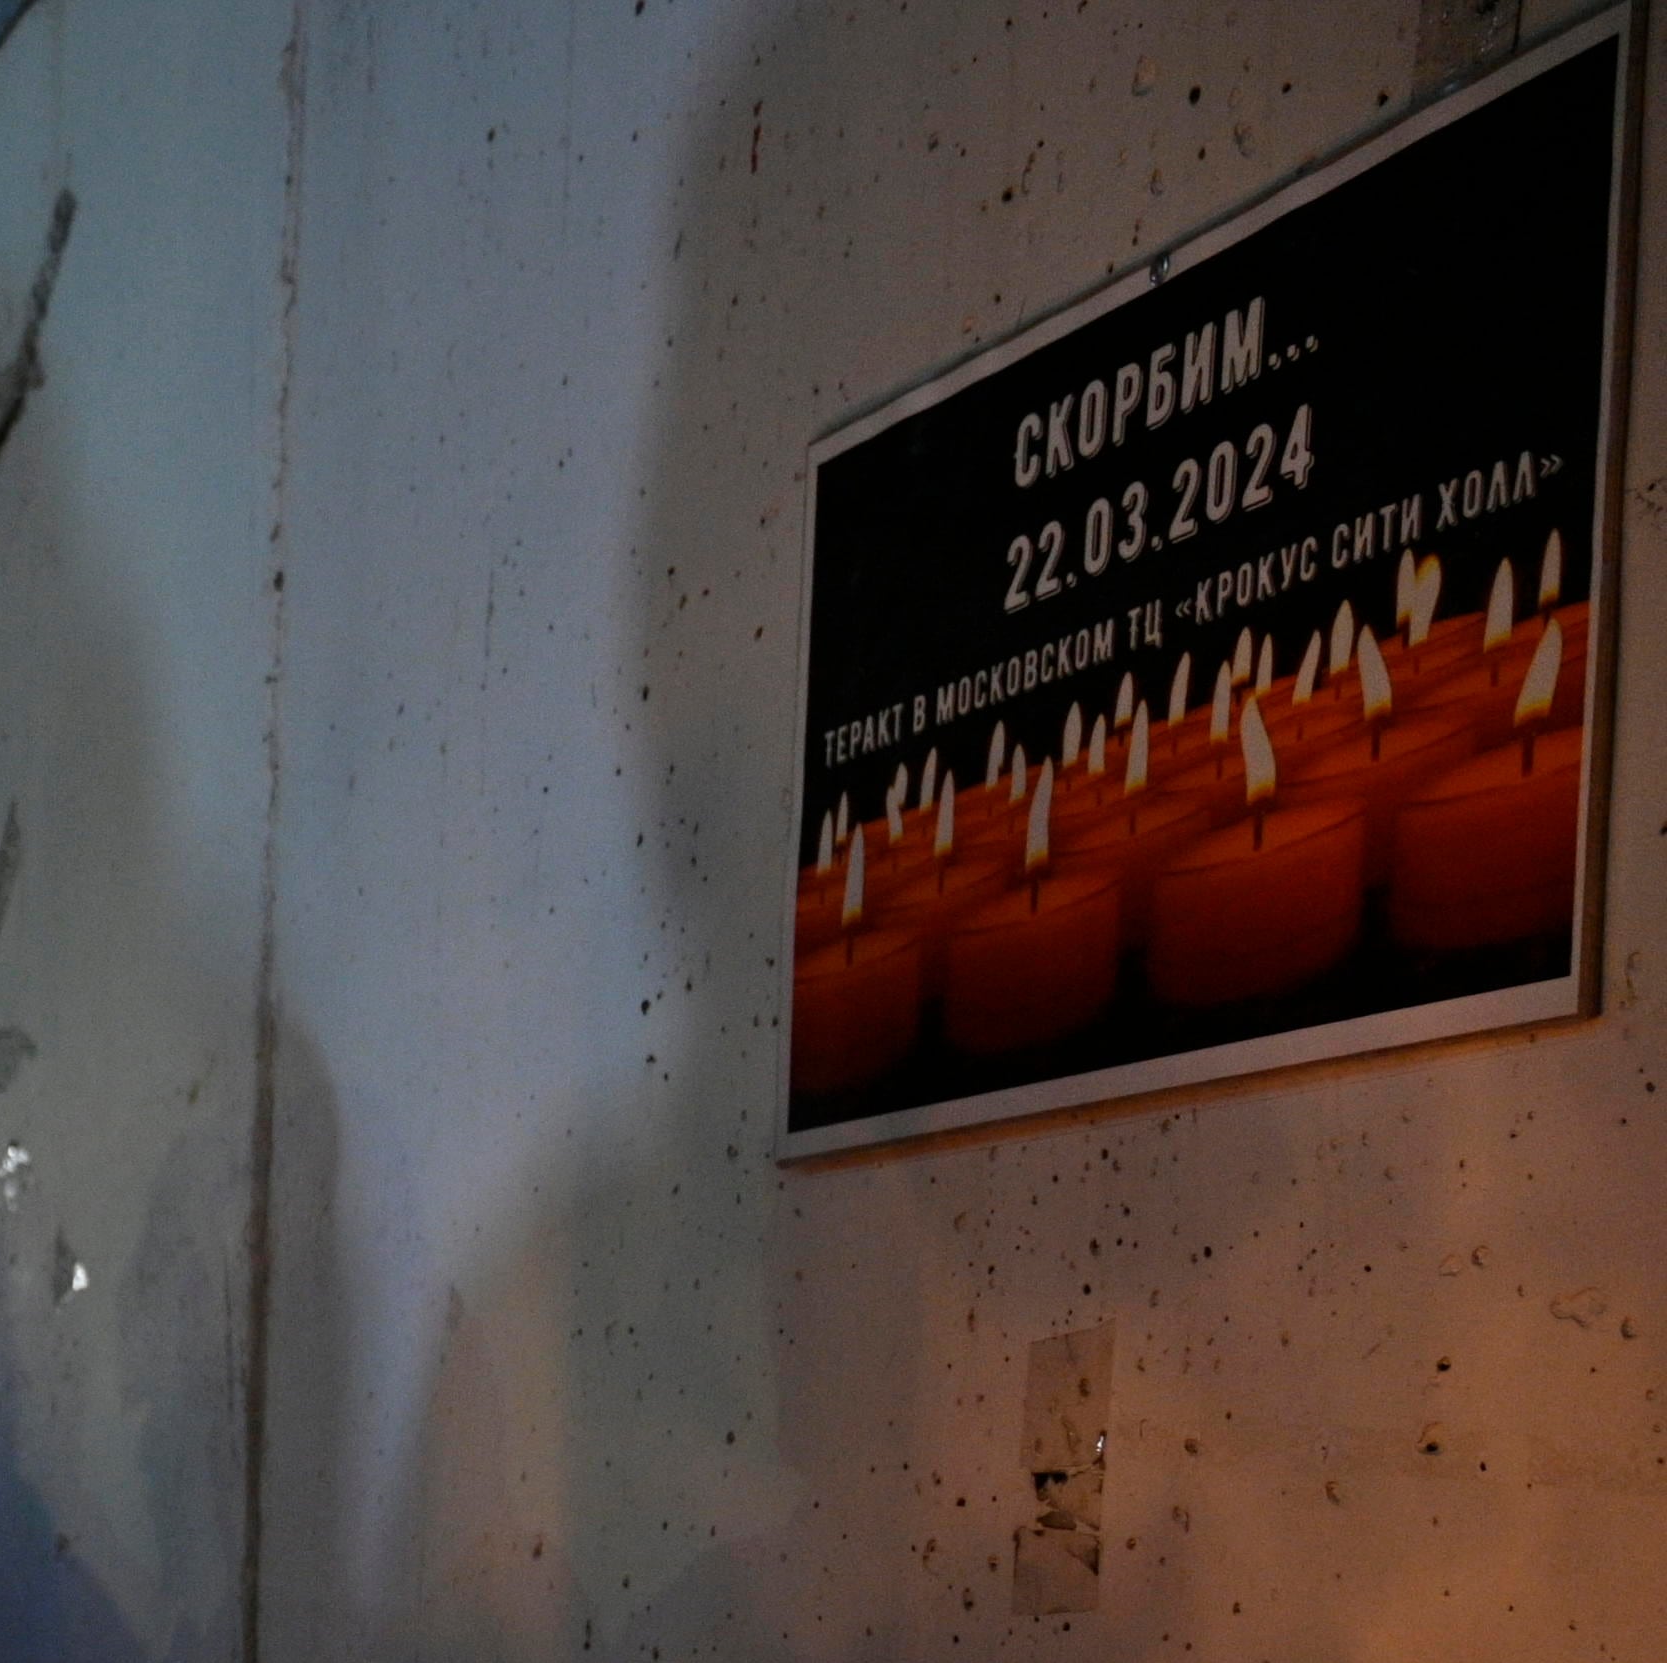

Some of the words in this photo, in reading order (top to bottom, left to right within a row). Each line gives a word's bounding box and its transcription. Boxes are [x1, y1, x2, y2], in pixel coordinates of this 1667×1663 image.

[1013, 294, 1319, 489] СКОРБИМ...
[823, 701, 905, 770] ТЕРАКТ
[912, 693, 928, 736] В
[935, 616, 1116, 727] МОСКОВСКОМ
[1126, 597, 1164, 651] ТЦ
[1174, 535, 1321, 626] «КРОКУС
[1330, 493, 1424, 570] СИТИ
[1435, 449, 1566, 533] ХОЛЛ»
[1002, 401, 1316, 616] 22.03.2024
